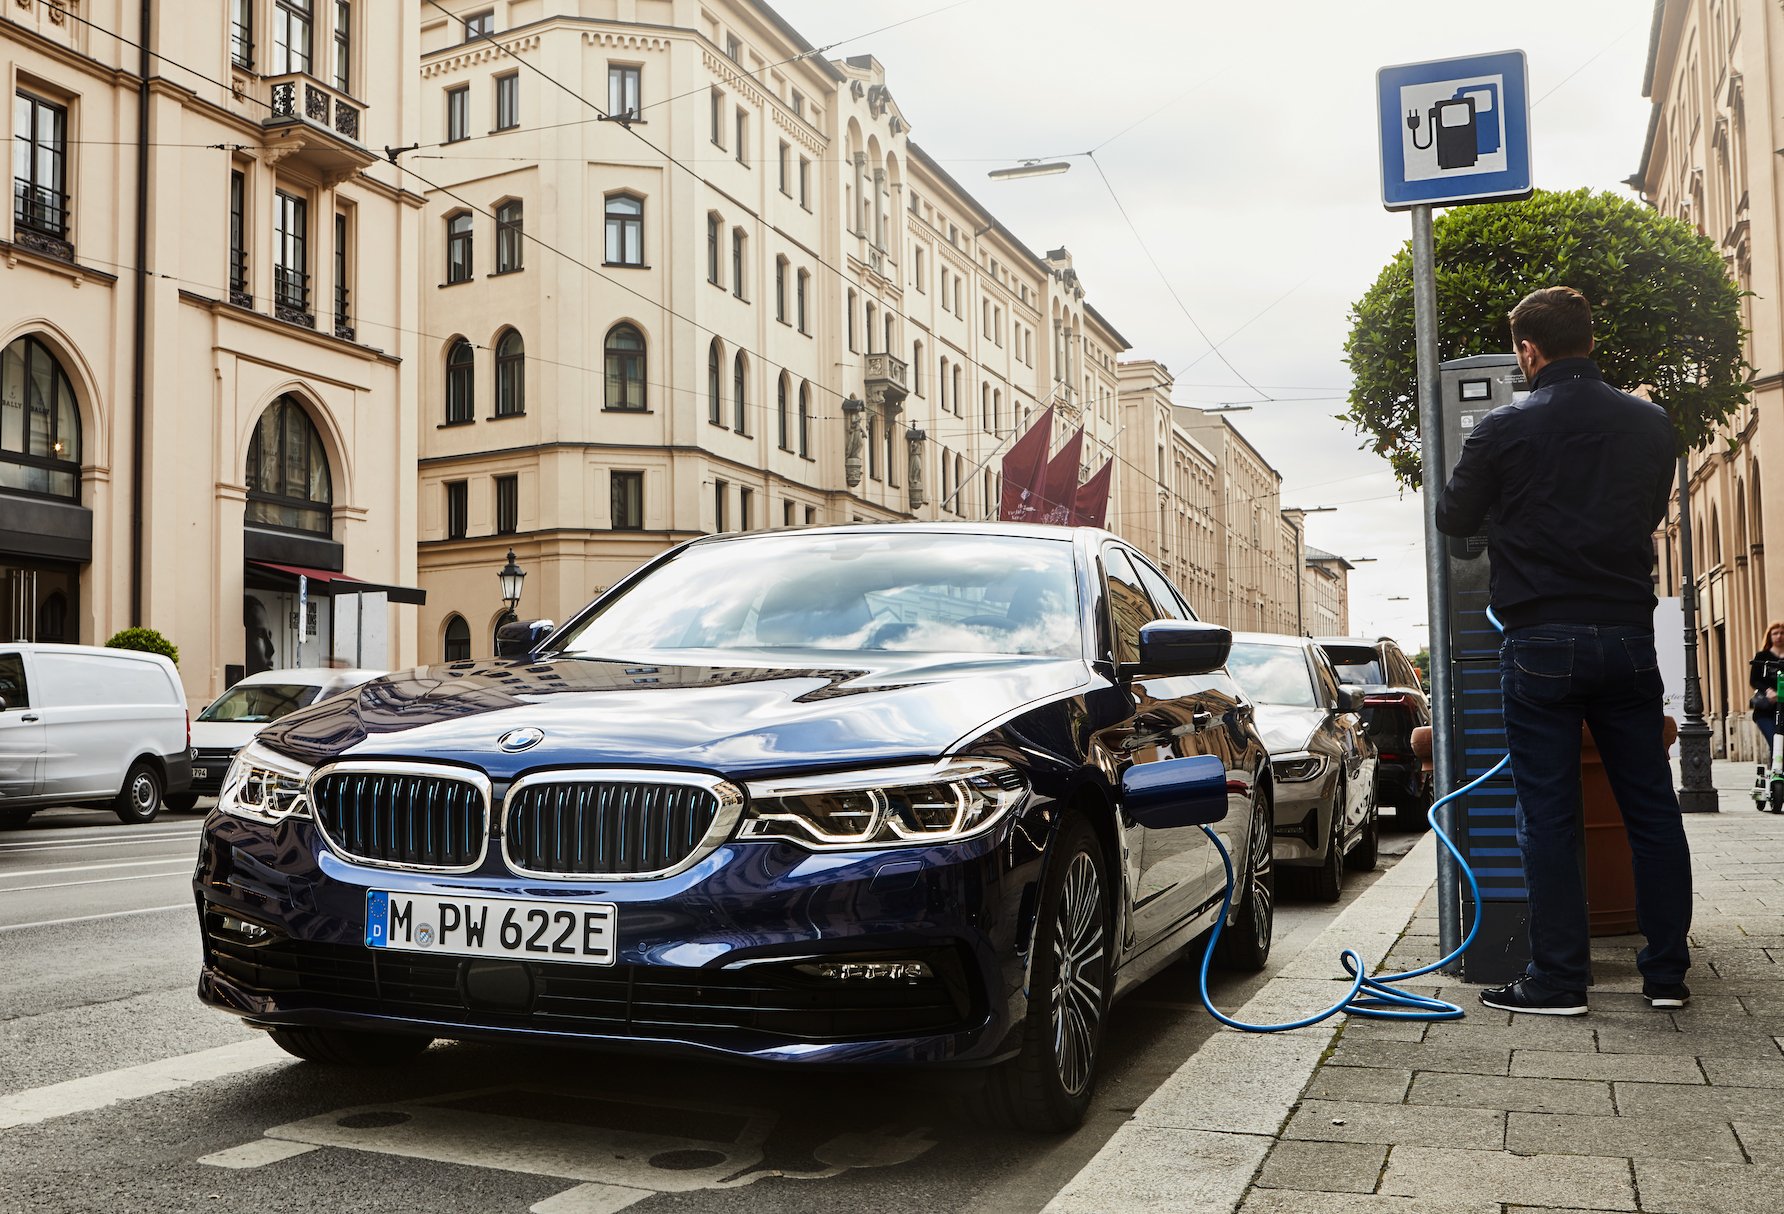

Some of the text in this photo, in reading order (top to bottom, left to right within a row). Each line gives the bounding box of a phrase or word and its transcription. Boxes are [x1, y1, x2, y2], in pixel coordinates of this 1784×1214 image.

[2, 400, 23, 409] BALLY
[373, 925, 382, 937] D
[389, 900, 608, 955] M PW 622E
